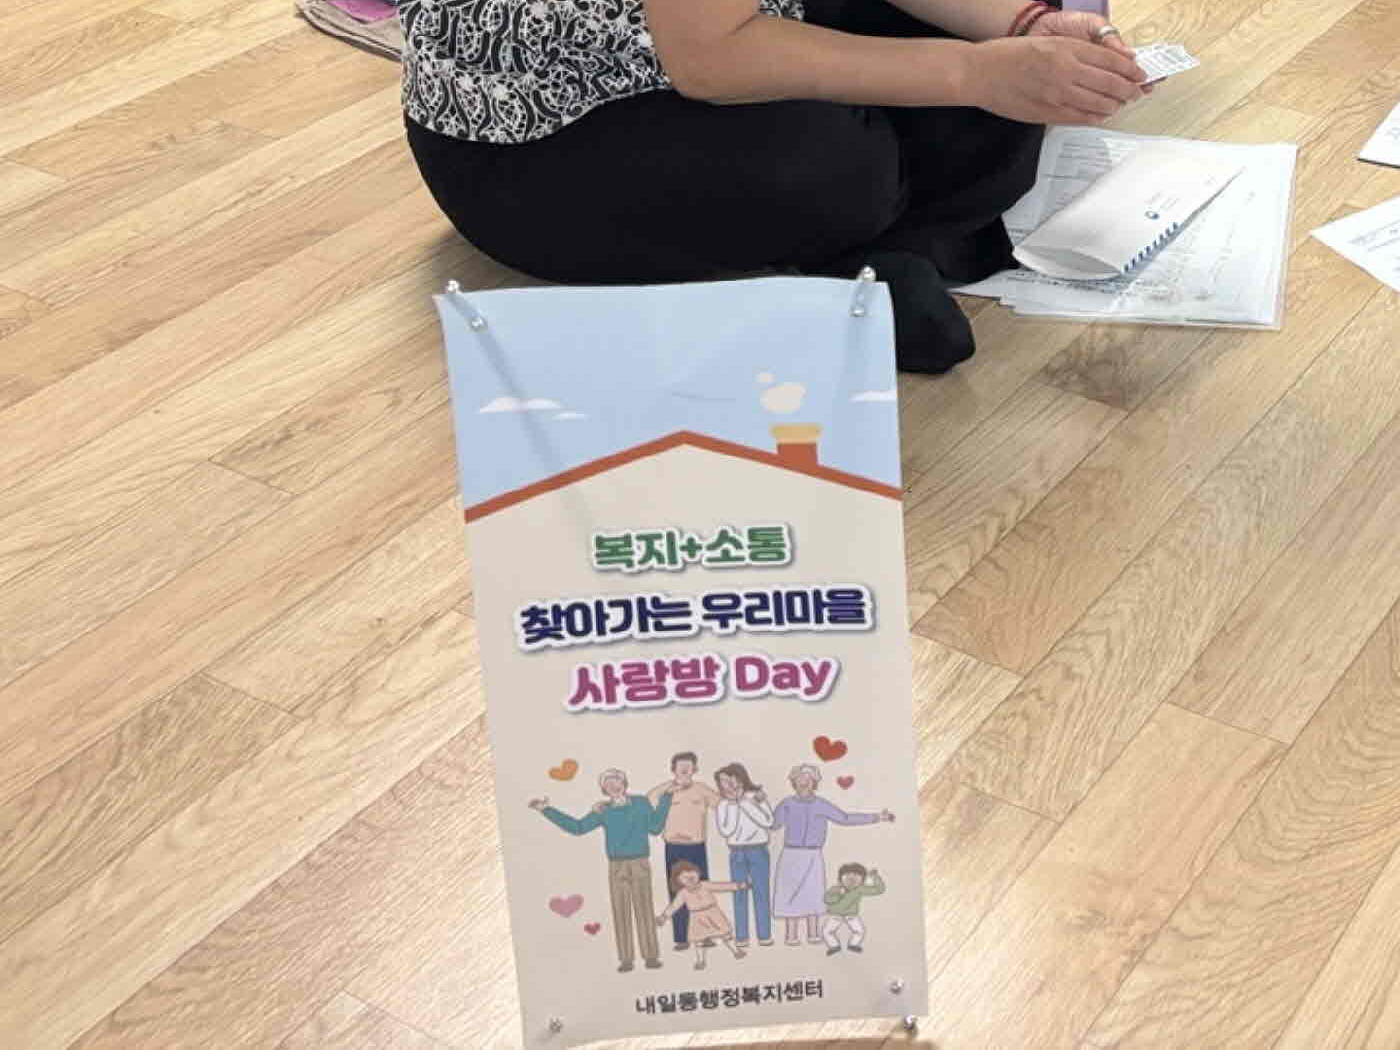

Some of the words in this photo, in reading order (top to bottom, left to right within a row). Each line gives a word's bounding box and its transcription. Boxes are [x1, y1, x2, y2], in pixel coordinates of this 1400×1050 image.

[594, 525, 788, 569] 복지+소통
[519, 594, 693, 645] 찾아가는
[701, 587, 867, 630] 우리마을
[567, 655, 720, 707] 사랑방
[734, 654, 833, 697] Day
[635, 978, 824, 1015] 내일동행정복지센터
